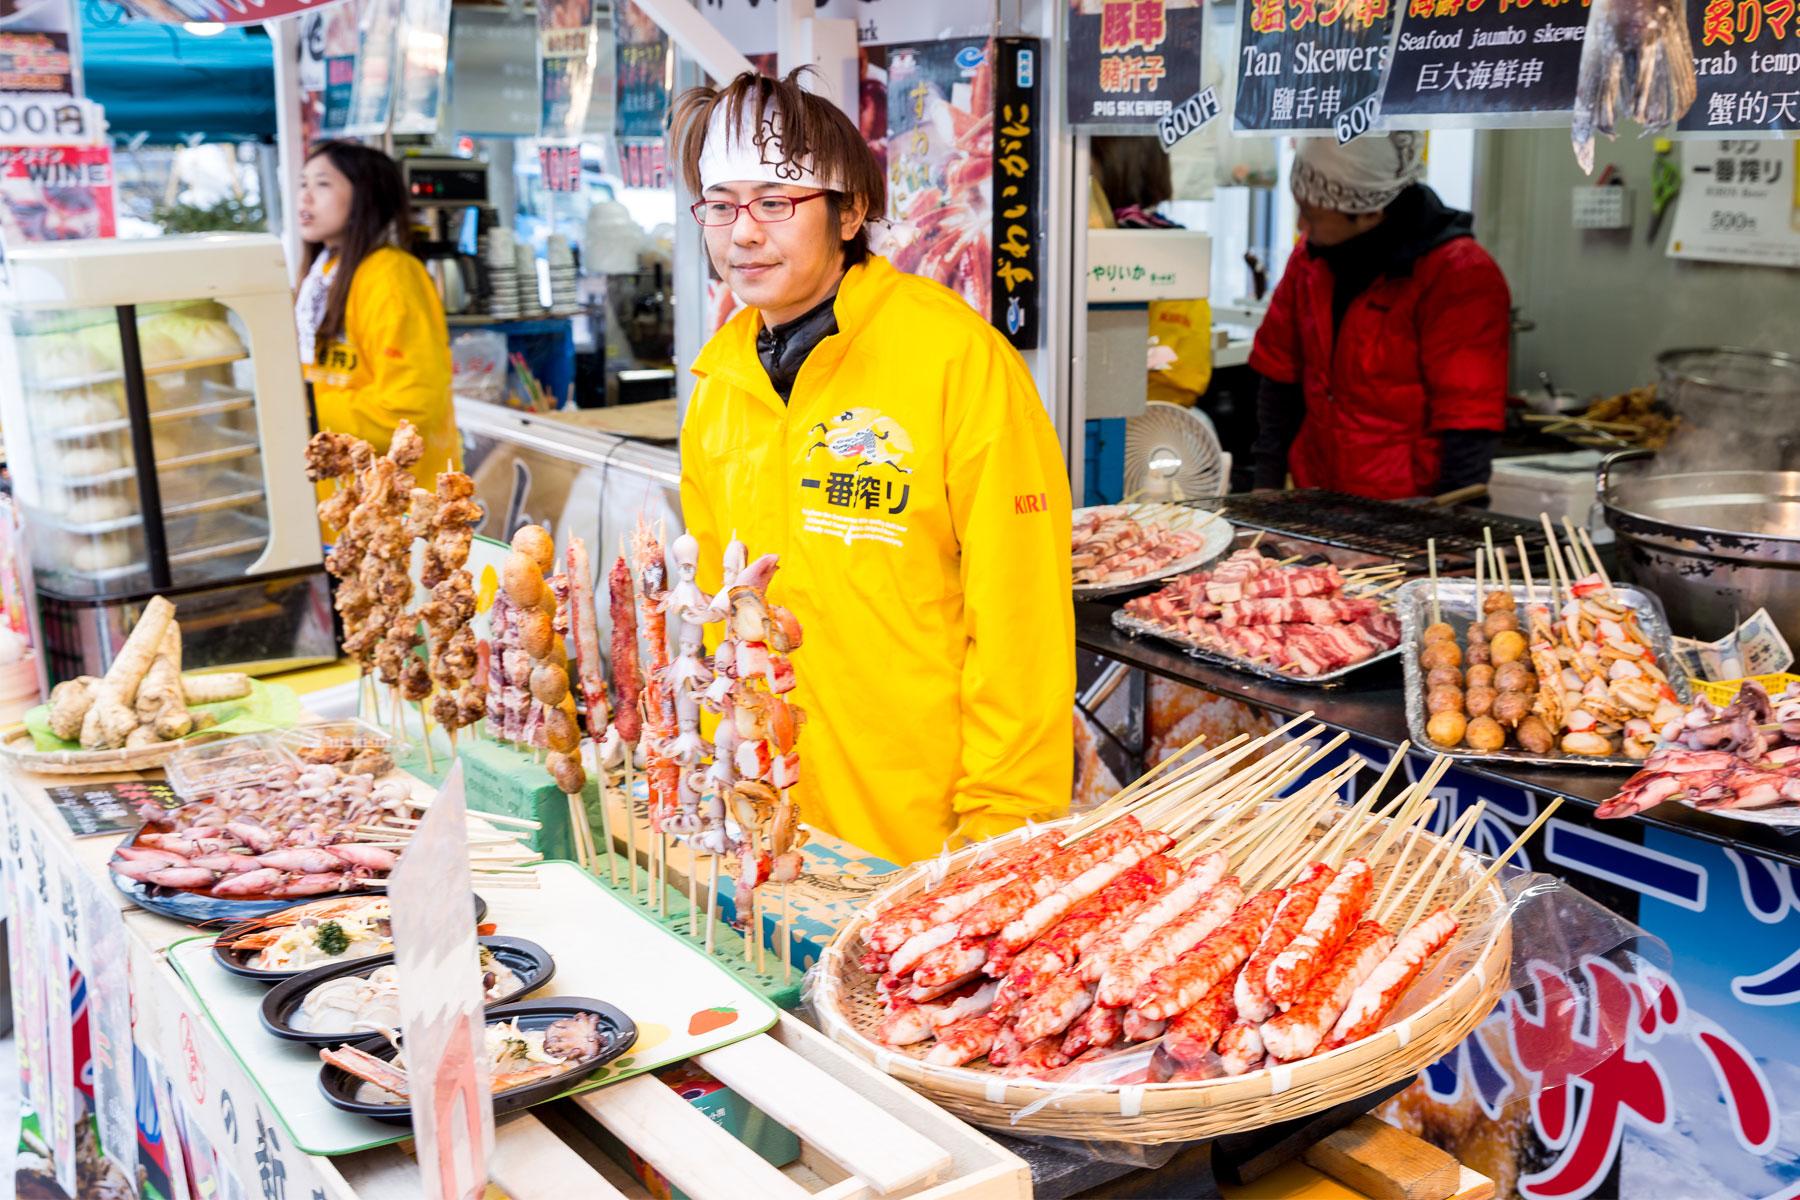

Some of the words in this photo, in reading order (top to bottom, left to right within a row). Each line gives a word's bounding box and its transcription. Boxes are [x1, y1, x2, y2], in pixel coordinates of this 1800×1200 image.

[1398, 28, 1463, 52] Seafood
[1467, 25, 1526, 50] jaumbo
[1532, 22, 1590, 44] skewe
[1702, 0, 1800, 46] 炙りマ
[1243, 45, 1282, 77] Tan
[1293, 40, 1388, 74] Skewers
[1416, 57, 1544, 92] 巨大海鮮串
[1092, 100, 1116, 117] PIG
[1117, 100, 1173, 117] SKEWER
[1161, 89, 1222, 145] 600円
